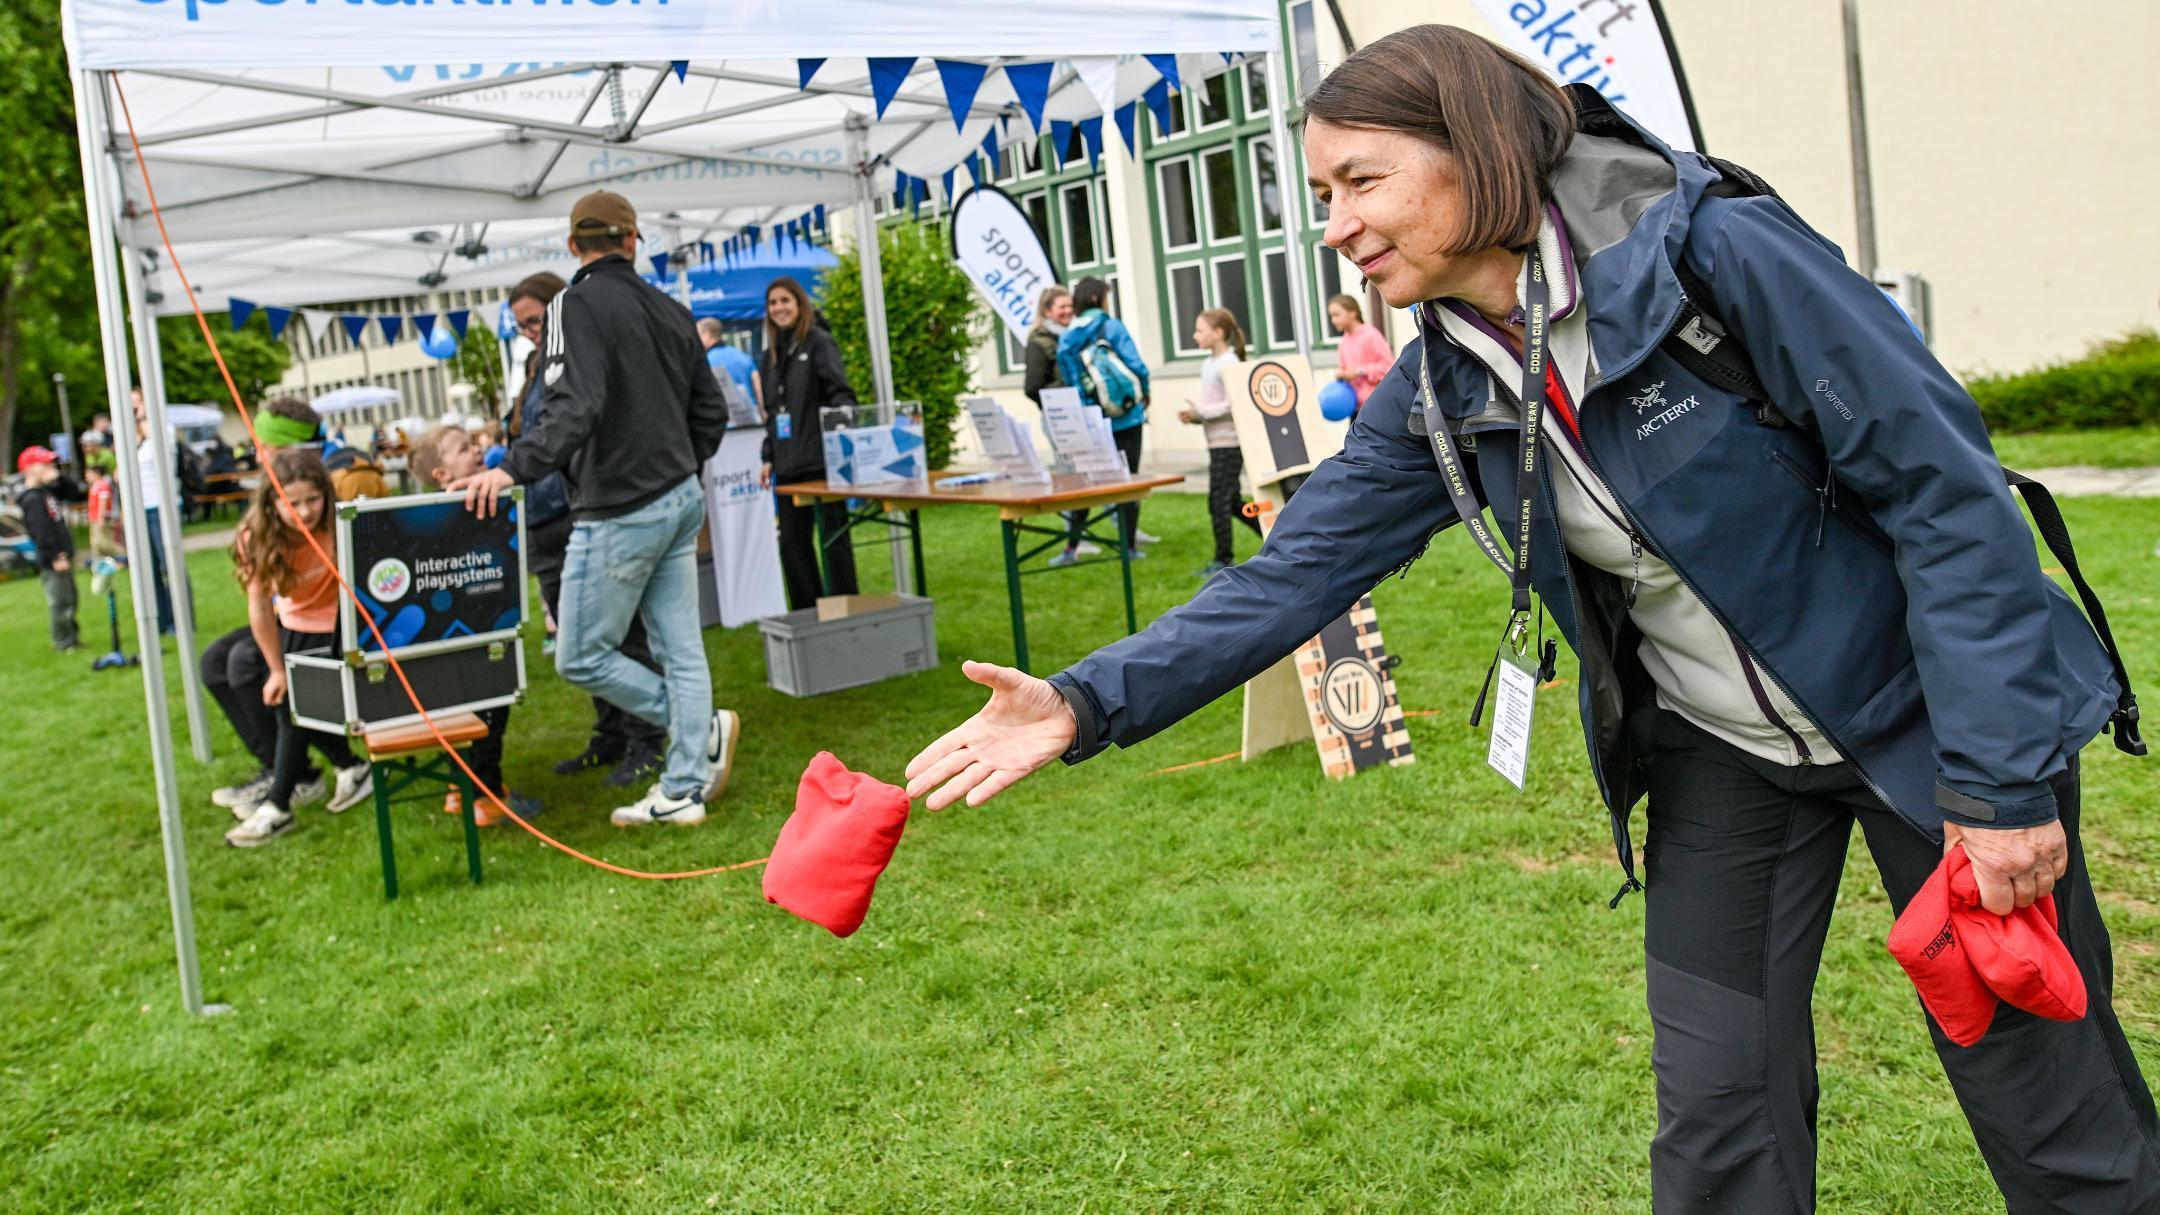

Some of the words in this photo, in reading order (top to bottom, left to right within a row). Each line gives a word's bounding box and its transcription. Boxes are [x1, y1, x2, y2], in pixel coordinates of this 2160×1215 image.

[981, 227, 1041, 291] sport
[1532, 303, 1544, 337] CLEAN
[1532, 338, 1542, 346] &
[1530, 346, 1541, 375] COOL
[1527, 401, 1538, 434] CLEAN
[1434, 430, 1450, 460] COOL
[1527, 436, 1536, 444] &
[1444, 456, 1453, 465] &
[1525, 445, 1535, 473] COOL
[712, 470, 751, 488] sport
[1448, 465, 1465, 496] CLEAN
[1521, 499, 1531, 533] CLEAN
[1471, 518, 1487, 543] COOL
[1490, 547, 1514, 573] CLEAN
[1521, 533, 1529, 541] &
[415, 551, 492, 574] interactive
[1519, 542, 1529, 570] COOL
[416, 566, 504, 593] playsystems
